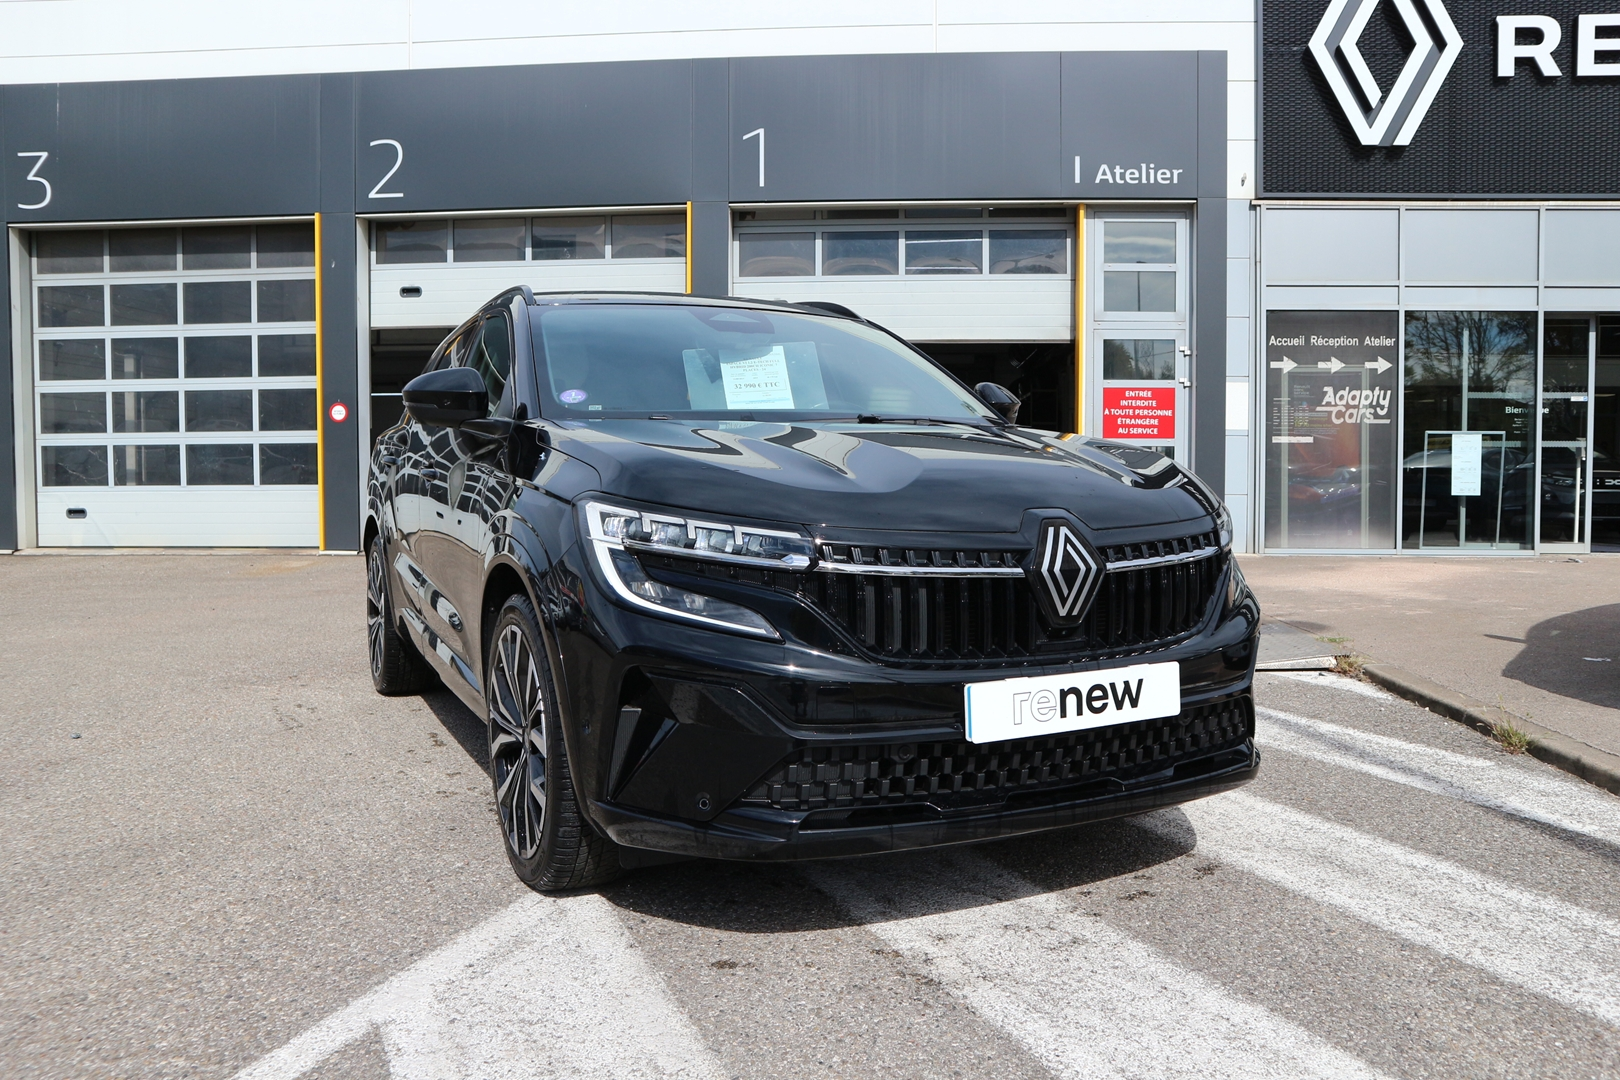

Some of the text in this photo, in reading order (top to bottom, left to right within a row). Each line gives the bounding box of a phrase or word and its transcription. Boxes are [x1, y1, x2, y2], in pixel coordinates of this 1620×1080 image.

[1496, 14, 1620, 77] RE
[367, 138, 405, 200] 2
[742, 128, 765, 188] 1
[1094, 163, 1183, 184] Atelier
[16, 151, 53, 210] 3
[1269, 335, 1396, 348] Accueil Réception Atelier
[1316, 406, 1391, 424] Cars
[1322, 386, 1391, 415] Adapty
[1117, 417, 1159, 425] ÉTRANGÈRE
[1012, 678, 1144, 725] renew
